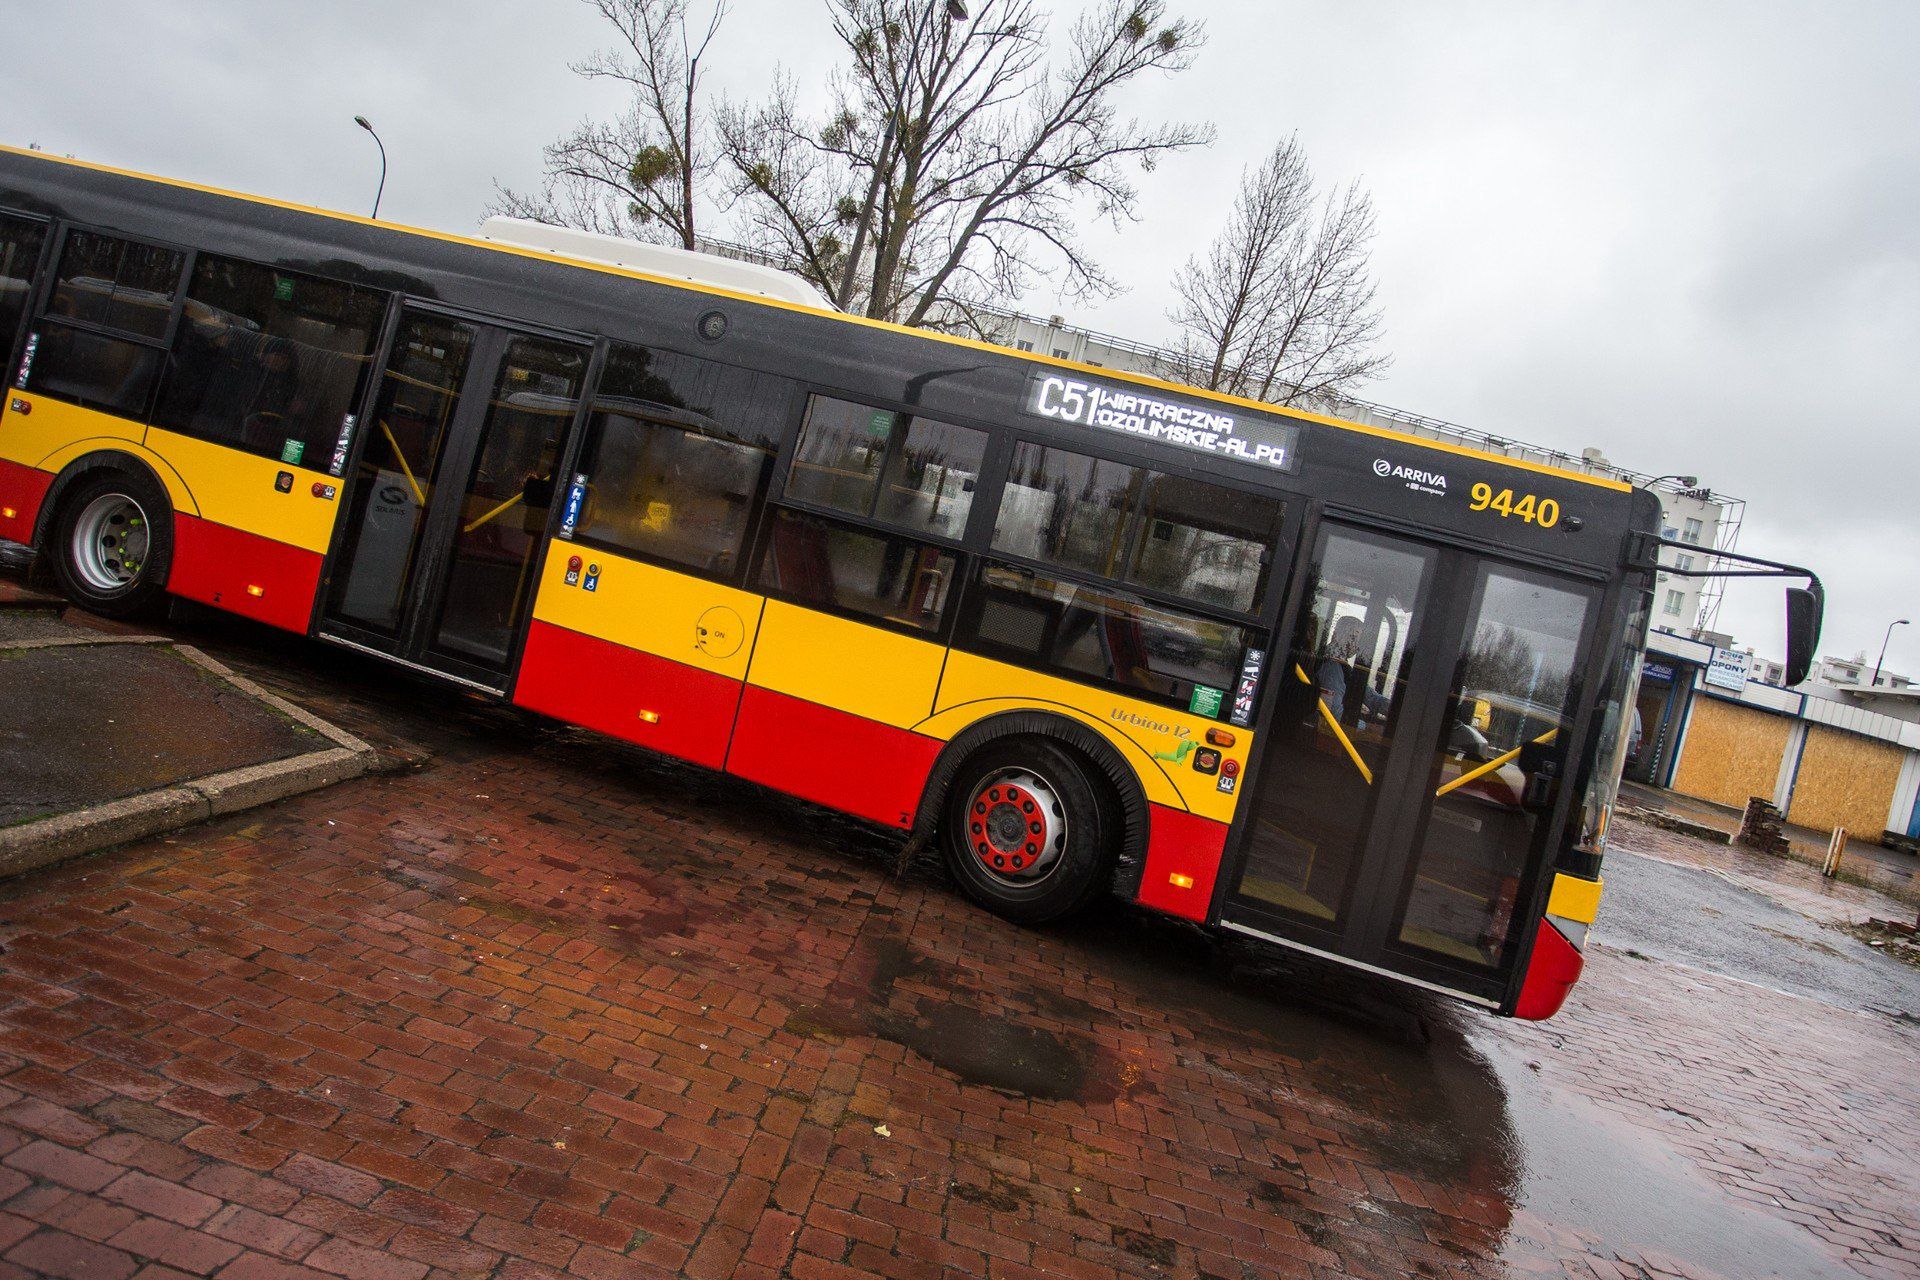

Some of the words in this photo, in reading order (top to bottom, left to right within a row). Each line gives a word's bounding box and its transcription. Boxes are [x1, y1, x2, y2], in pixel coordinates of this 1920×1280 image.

[1038, 377, 1101, 426] C51
[1099, 390, 1235, 435] WIATRACZNA
[1095, 408, 1285, 466] OZOLIMSKIE-AL.PO
[1392, 465, 1447, 488] ARRIVA
[1419, 486, 1446, 497] company
[1469, 482, 1560, 528] 9440
[1711, 660, 1747, 674] OPONY
[1110, 707, 1170, 735] Urbino
[1173, 724, 1191, 740] 12
